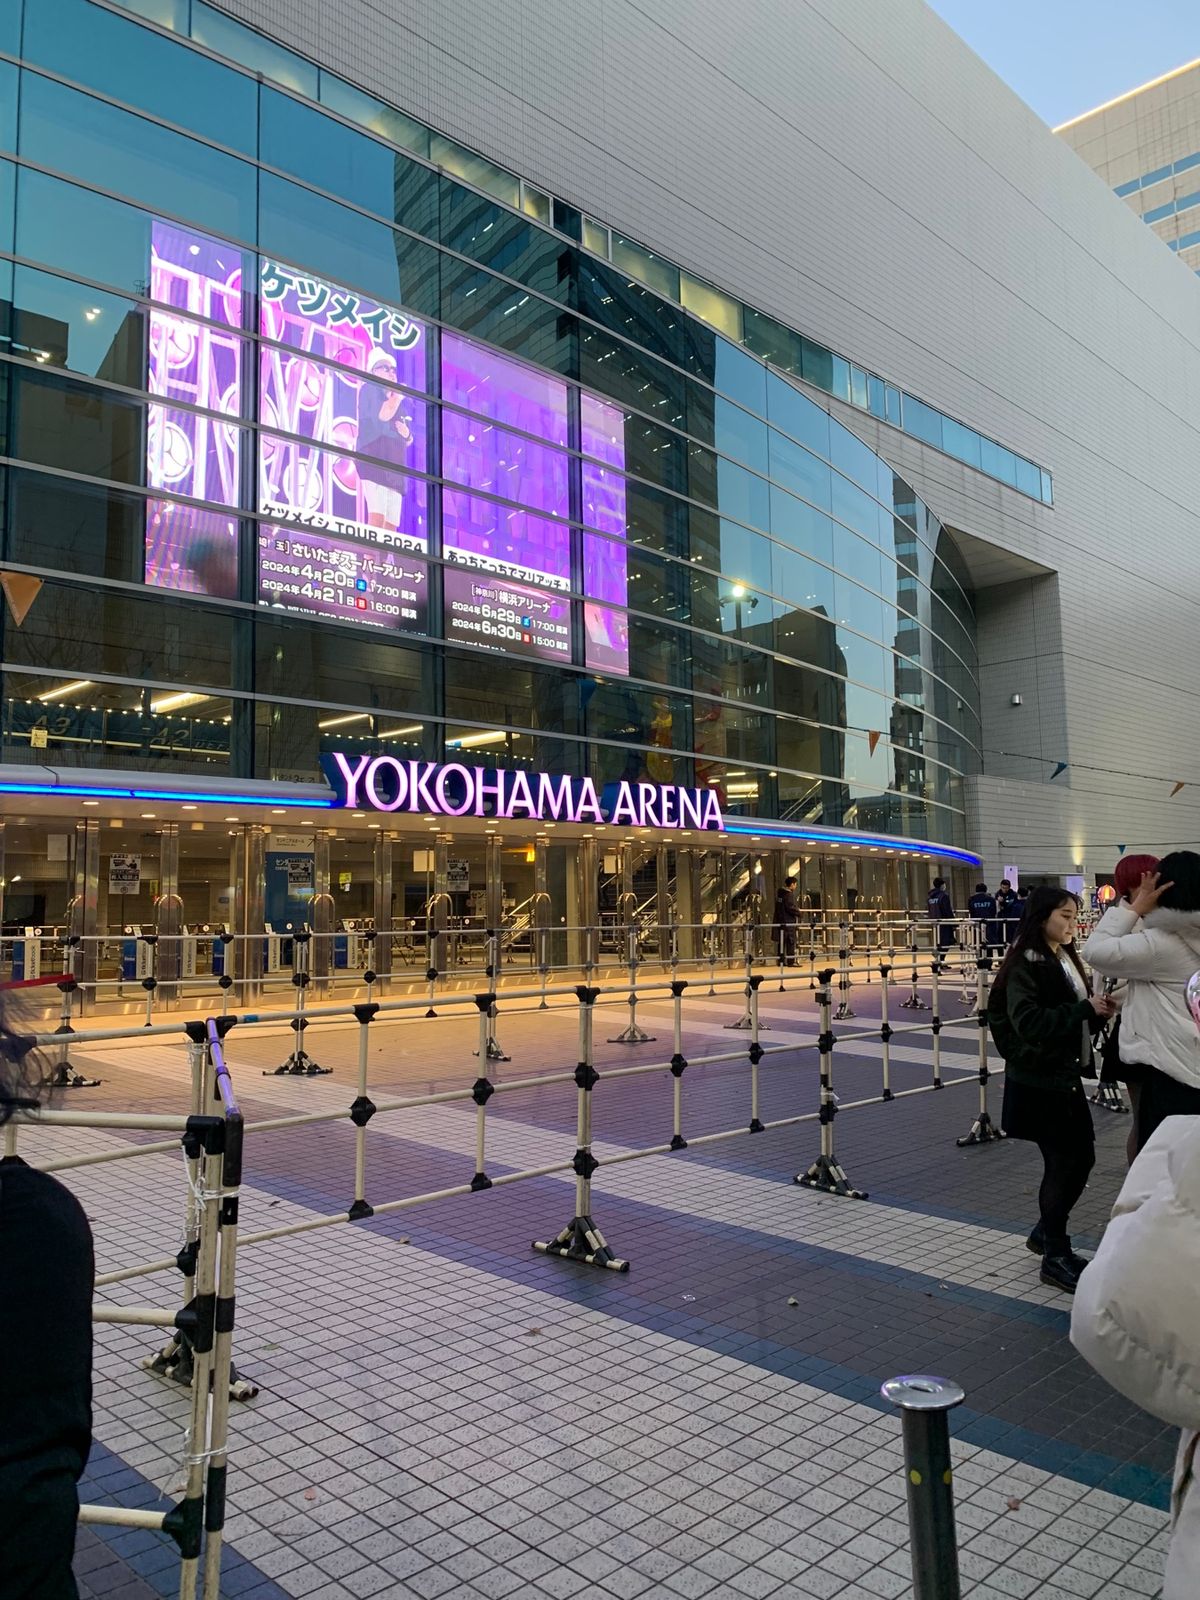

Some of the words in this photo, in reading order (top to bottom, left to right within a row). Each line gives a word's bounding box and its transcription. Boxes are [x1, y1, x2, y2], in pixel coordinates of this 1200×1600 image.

[261, 262, 421, 350] ケツメイシ
[335, 521, 378, 542] TOUR
[383, 534, 423, 553] 2024
[332, 752, 605, 824] YOKOHAMA
[610, 780, 725, 831] ARENA
